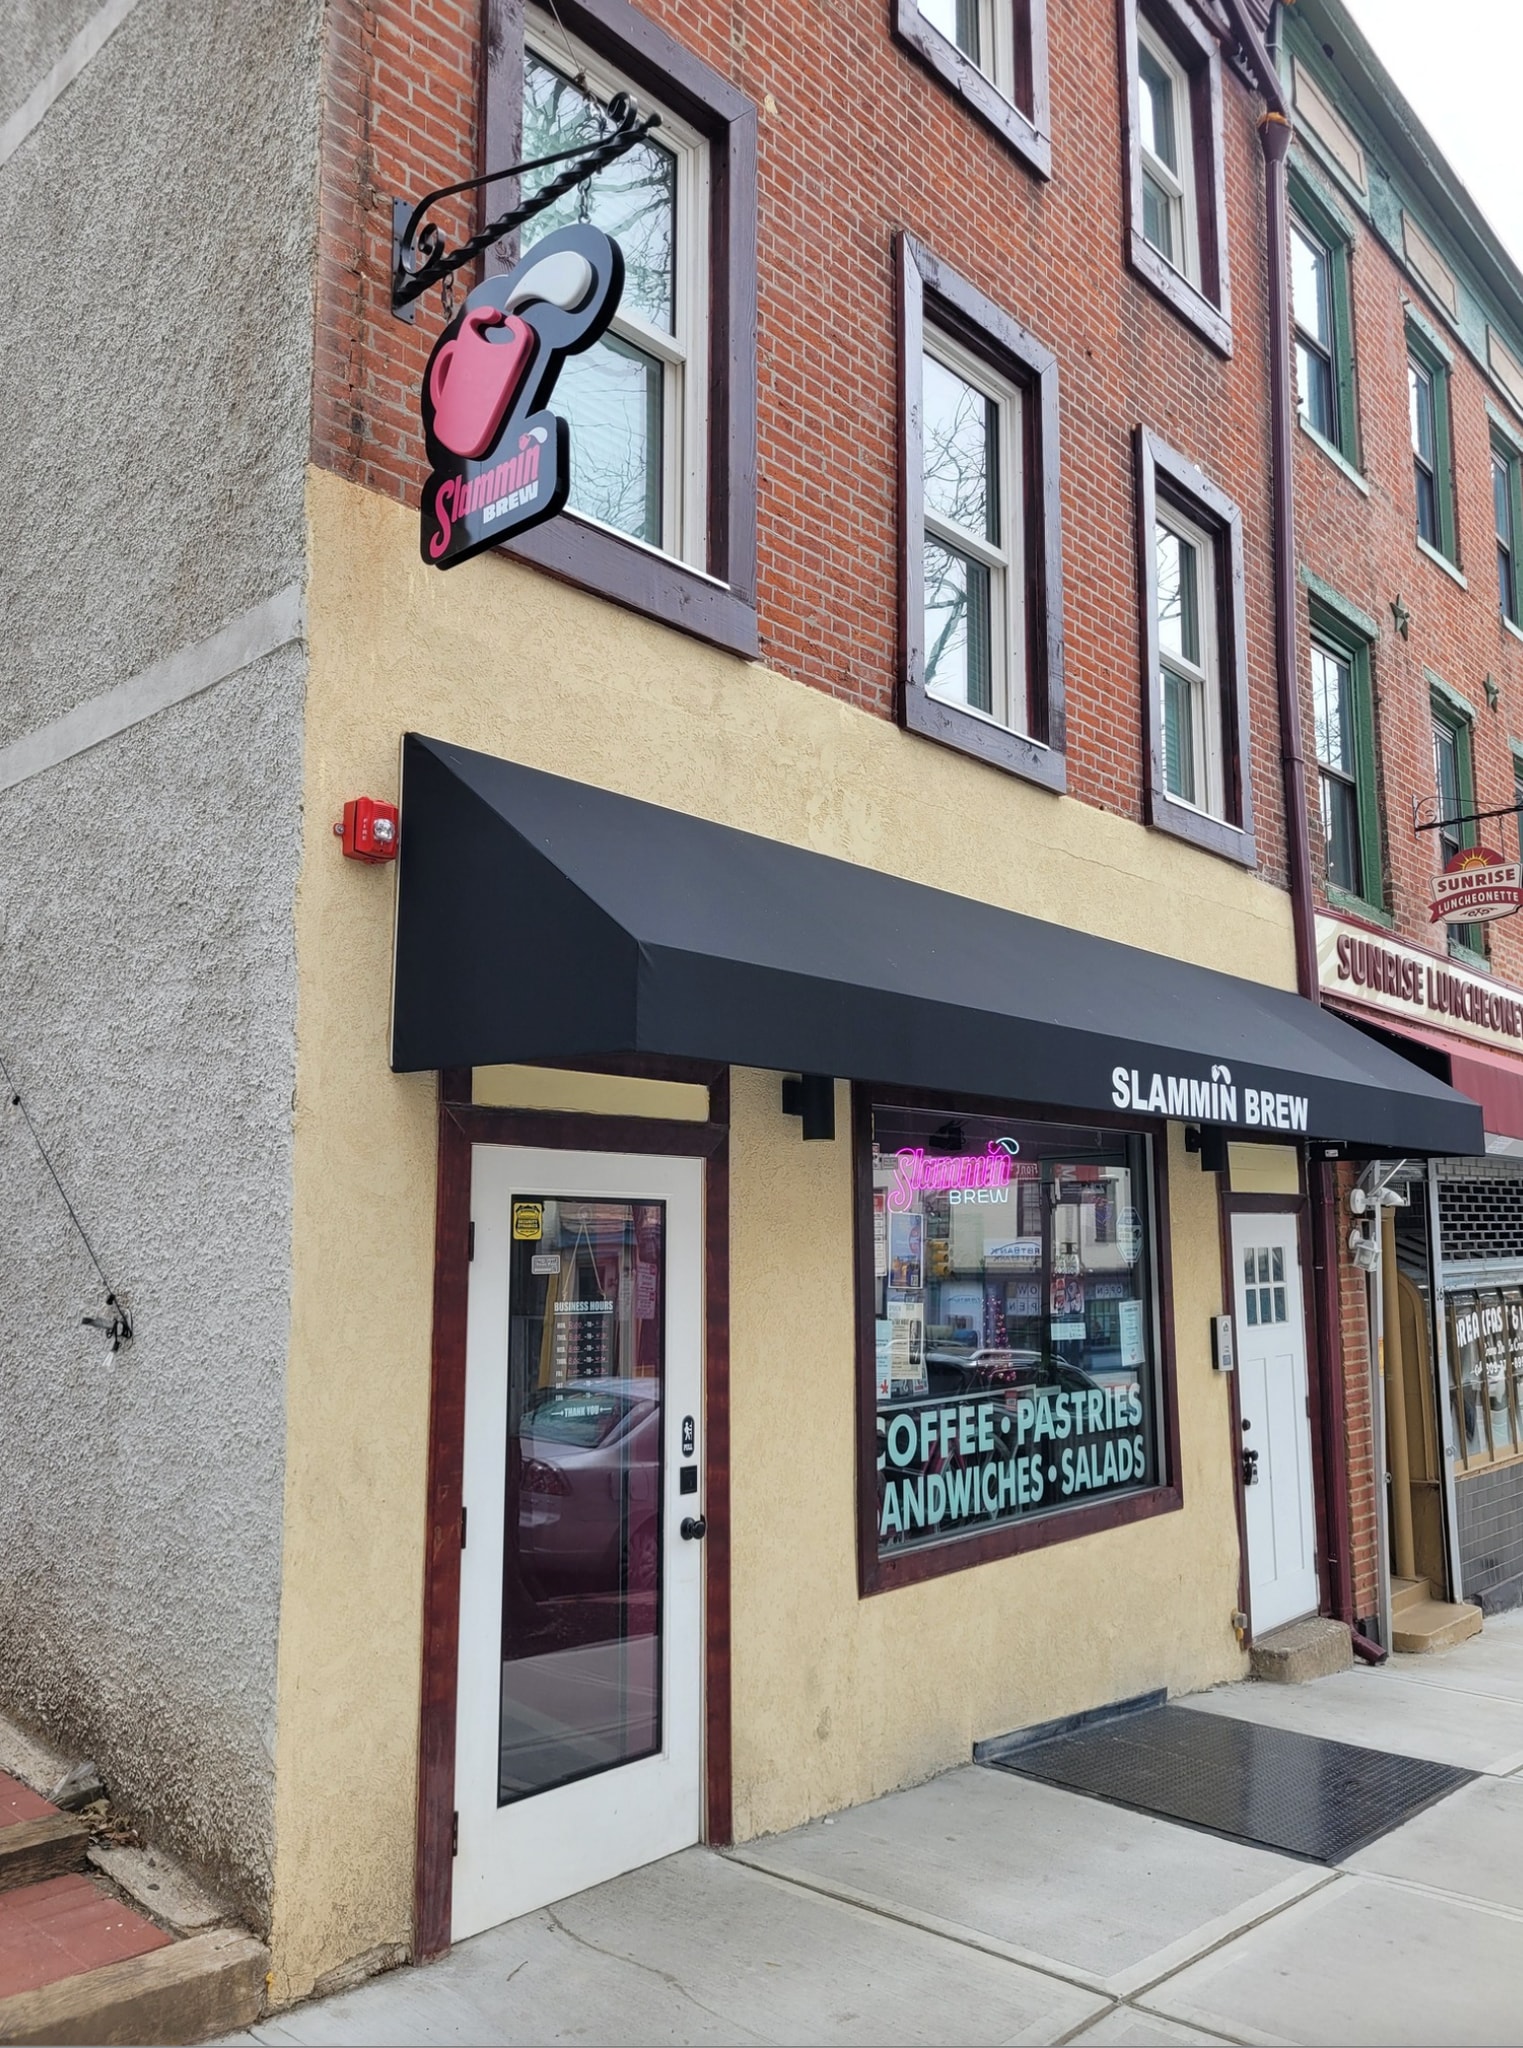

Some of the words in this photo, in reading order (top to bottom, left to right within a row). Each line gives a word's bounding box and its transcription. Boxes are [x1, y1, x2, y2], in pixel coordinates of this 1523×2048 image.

[430, 433, 541, 559] Slammin
[483, 480, 539, 524] BREW
[1437, 868, 1516, 893] SUNRISE
[1438, 890, 1520, 914] LUNCHEONETTE
[1337, 934, 1425, 1006] SUNRISE
[1111, 1066, 1238, 1123] SLAMMIN
[1244, 1087, 1309, 1132] BREW
[887, 1145, 1012, 1213] Slammin
[949, 1188, 1009, 1205] BREW
[554, 1301, 589, 1312] BUSINESS
[590, 1301, 613, 1311] HOURS
[564, 1406, 586, 1418] THANK
[587, 1405, 600, 1416] YOU
[1017, 1383, 1143, 1446] PASTRIES
[877, 1454, 1044, 1536] ANDWICHES
[1062, 1434, 1146, 1495] SALADS
